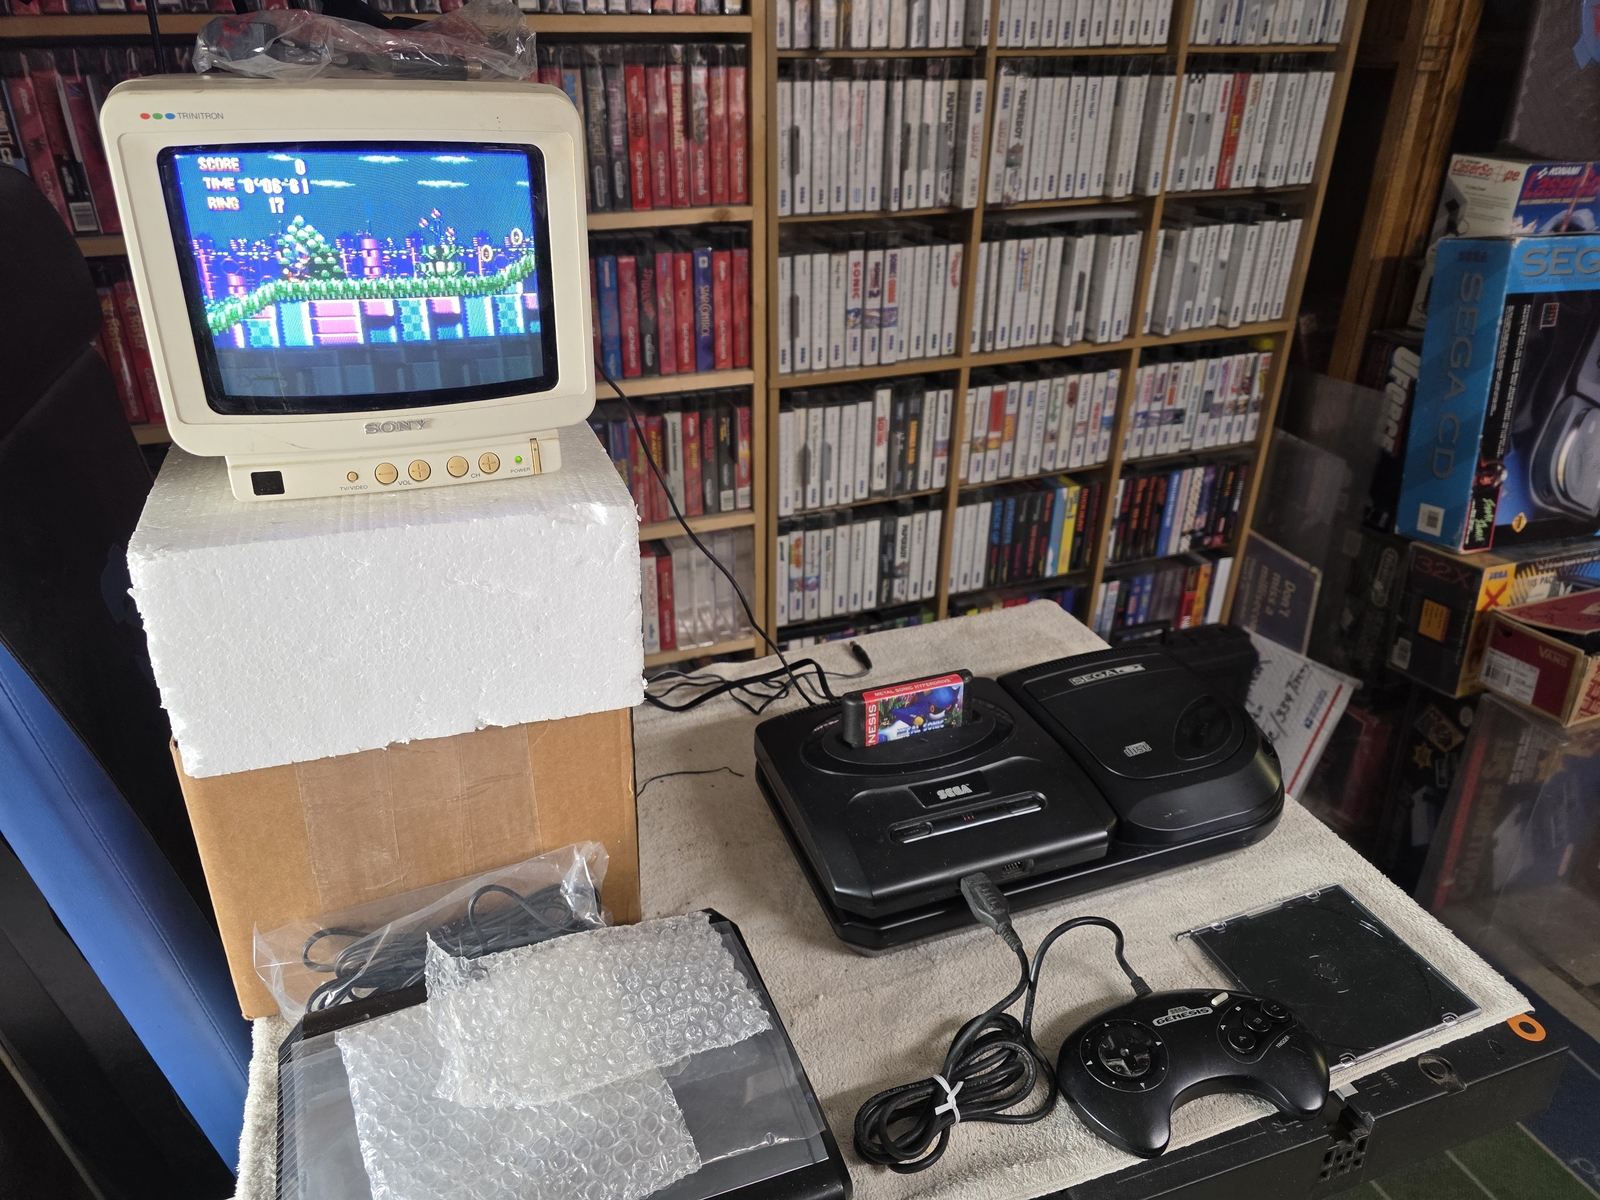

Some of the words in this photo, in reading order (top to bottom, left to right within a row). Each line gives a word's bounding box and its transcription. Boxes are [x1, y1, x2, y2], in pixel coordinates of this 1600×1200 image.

[672, 86, 684, 123] PRIMAL
[975, 90, 983, 114] SEGA
[1002, 86, 1011, 110] SEGA
[177, 112, 224, 120] TRINITRON
[1014, 89, 1027, 139] PAPERBOY
[673, 124, 684, 150] RAGE
[198, 156, 241, 172] SCORE
[294, 158, 306, 175] 0
[634, 152, 645, 199] GENESIS
[657, 151, 666, 197] GENESIS
[675, 152, 685, 198] GENESIS
[696, 149, 706, 196] GENESIS
[716, 148, 724, 194] GENESIS
[735, 148, 744, 193] GENESIS
[1548, 166, 1582, 176] KONAMI
[203, 177, 236, 191] TIME
[207, 196, 240, 211] RING
[872, 261, 881, 288] SONIC
[889, 253, 897, 275] SONIC
[852, 261, 861, 299] SONIC
[887, 278, 897, 303] CHAOS
[700, 285, 710, 304] STAR
[868, 289, 880, 298] 2
[699, 304, 712, 339] CONTROL
[627, 326, 637, 368] GENESIS
[682, 322, 690, 364] GENESIS
[720, 320, 728, 360] GENESIS
[1445, 272, 1484, 399] SEGA
[145, 367, 160, 413] GENESIS
[363, 419, 428, 434] SONY
[1433, 412, 1461, 480] CD
[1080, 488, 1089, 510] DUCK
[900, 524, 909, 559] PAPERBOY
[1415, 554, 1474, 590] 32X
[647, 564, 657, 617] MONOPOLY
[1538, 645, 1570, 669] VANS
[874, 689, 894, 697] METAL
[895, 685, 914, 693] SONIC
[914, 678, 951, 689] HYPERDRIVE
[1072, 667, 1119, 685] SEGA
[922, 718, 946, 732] SONIC
[937, 784, 973, 800] SEGA
[1156, 1007, 1210, 1024] GENESIS
[1276, 1035, 1290, 1049] TRIGGER
